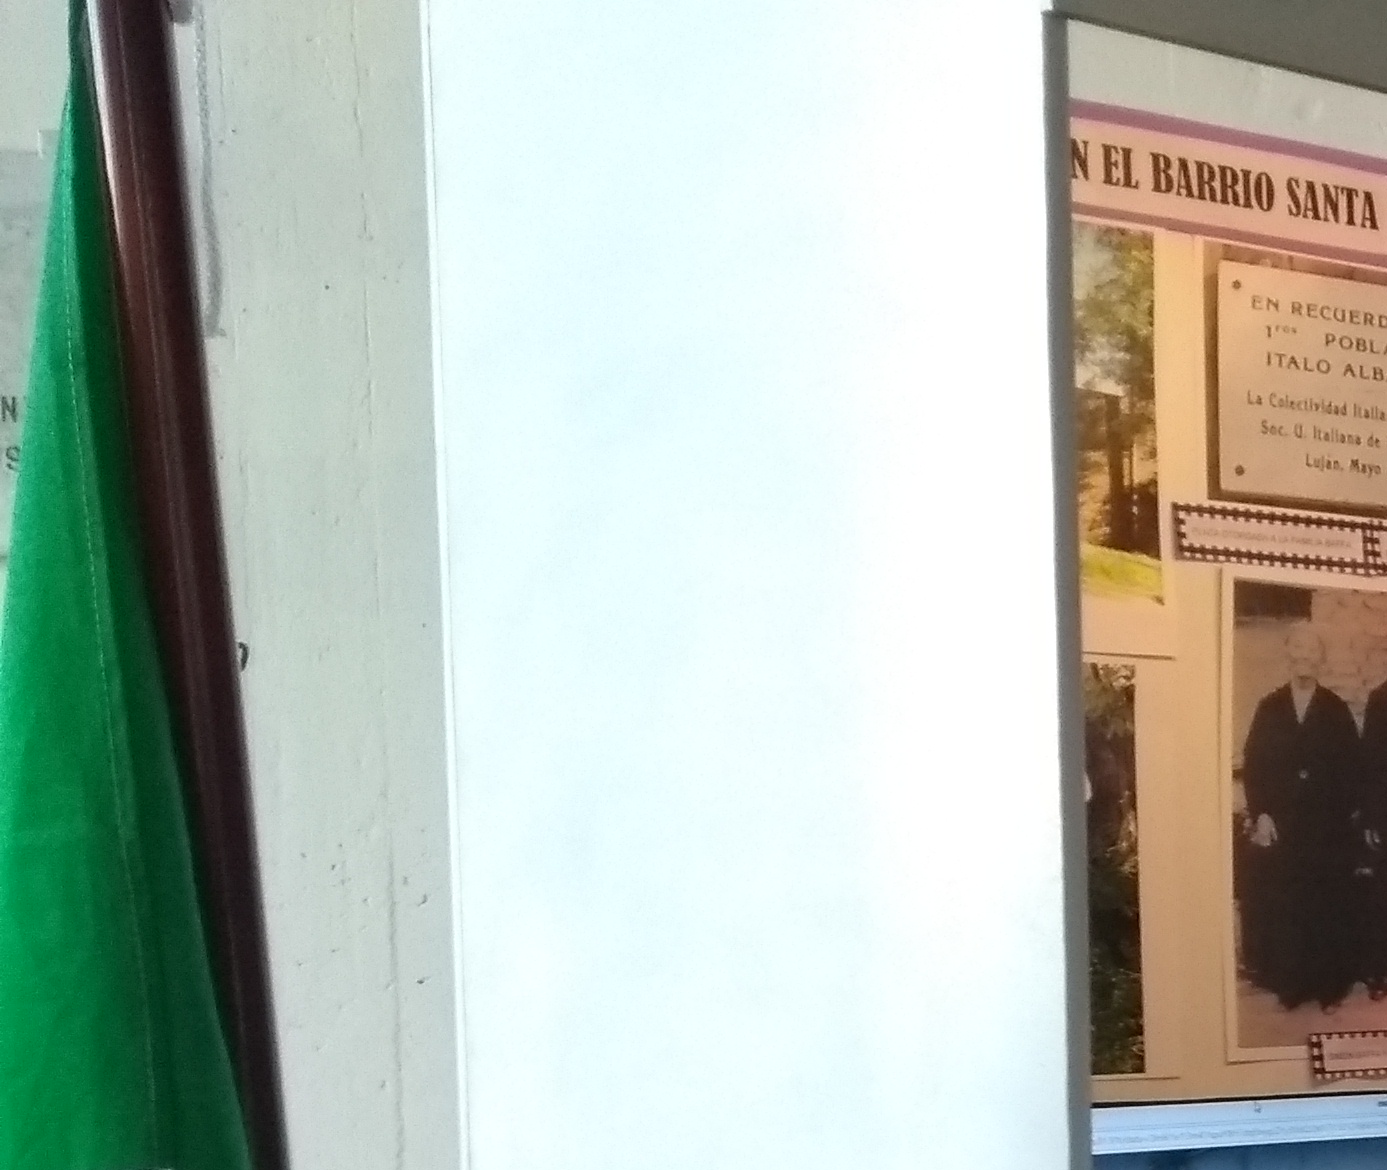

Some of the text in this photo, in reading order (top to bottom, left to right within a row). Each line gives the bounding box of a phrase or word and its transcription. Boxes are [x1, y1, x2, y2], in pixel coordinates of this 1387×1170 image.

[1070, 137, 1090, 182] N
[1101, 142, 1140, 190] EL
[1150, 151, 1276, 213] BARRIO
[1286, 175, 1380, 232] SANTA
[1250, 294, 1280, 313] EN
[1265, 351, 1332, 375] ITALO
[1246, 389, 1264, 406] La
[1268, 391, 1349, 417] Colectividad
[1312, 424, 1363, 448] Italiana
[1366, 433, 1382, 449] de
[1349, 458, 1383, 479] Mayo
